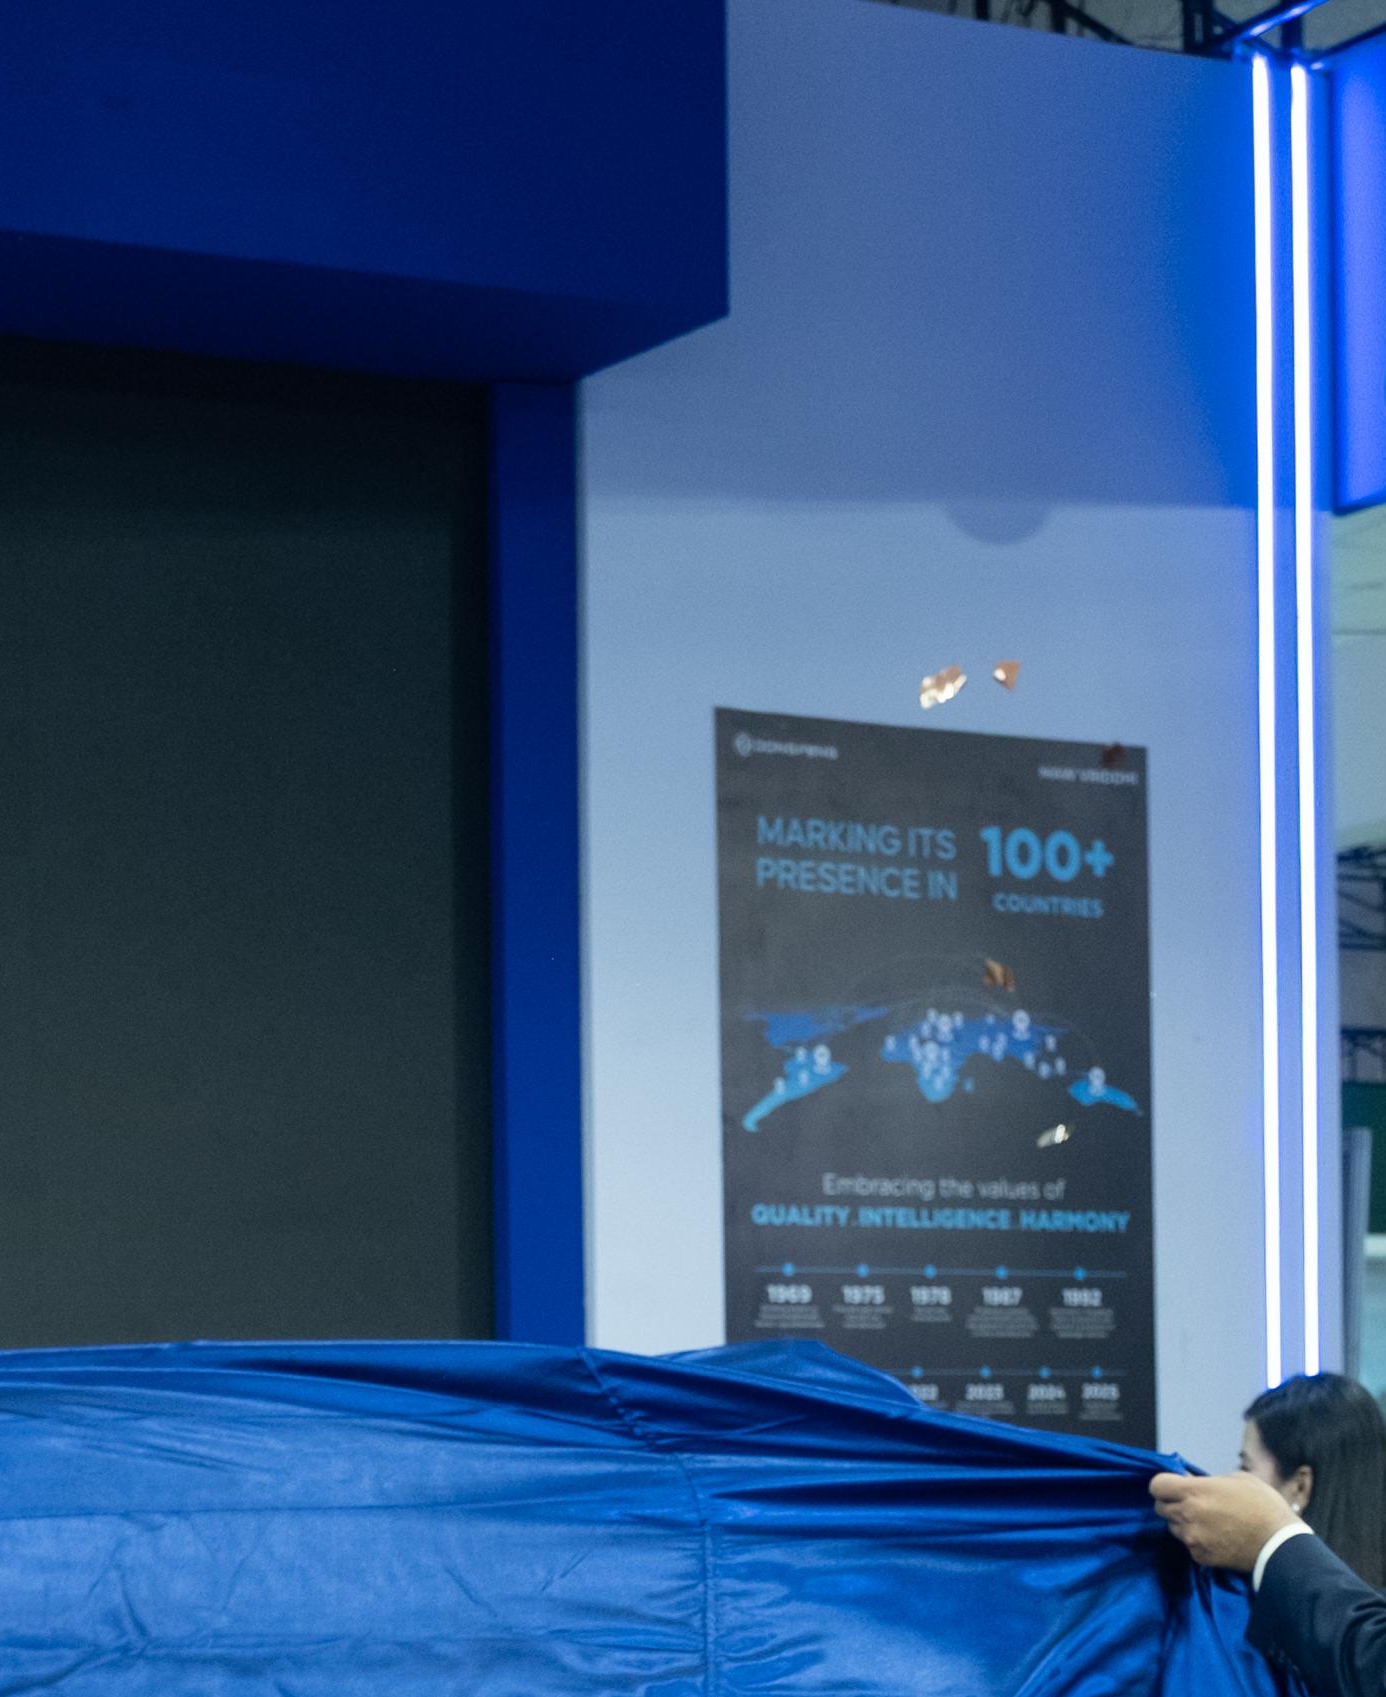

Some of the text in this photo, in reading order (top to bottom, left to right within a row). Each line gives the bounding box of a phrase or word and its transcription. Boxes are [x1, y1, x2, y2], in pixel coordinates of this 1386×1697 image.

[757, 815, 957, 860] MARKING ITS
[980, 824, 1113, 882] 100+
[757, 857, 958, 900] PRESENCE IN
[991, 892, 1105, 919] COUNTRIES
[822, 1172, 1067, 1201] Embracing the values of
[751, 1203, 851, 1227] QUALITY
[1019, 1210, 1131, 1232] HARMONY
